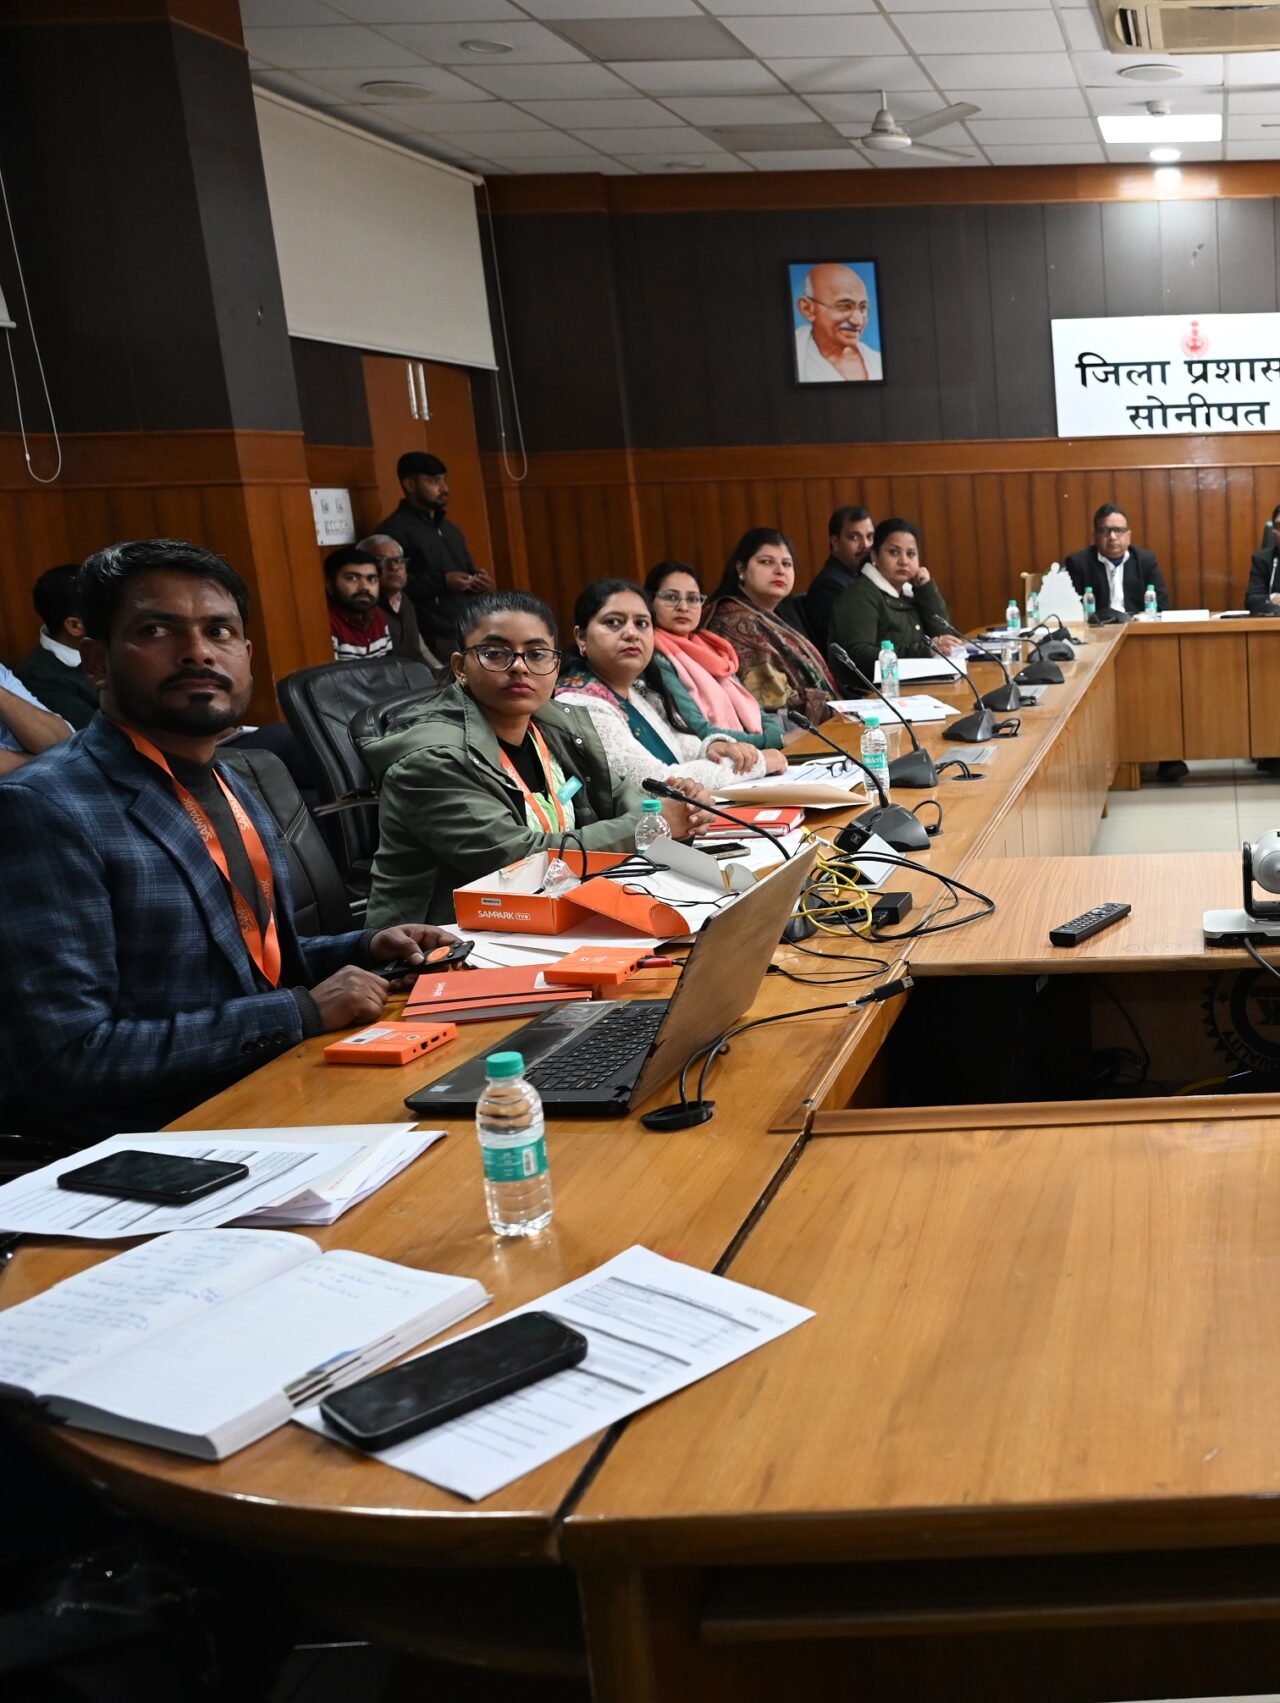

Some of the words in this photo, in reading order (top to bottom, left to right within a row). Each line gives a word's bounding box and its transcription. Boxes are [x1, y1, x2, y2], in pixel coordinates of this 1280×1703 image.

[1075, 351, 1171, 388] जिला
[1126, 392, 1270, 430] सोनीपत
[184, 797, 213, 842] SAMPARK
[477, 909, 515, 920] SAMPARK
